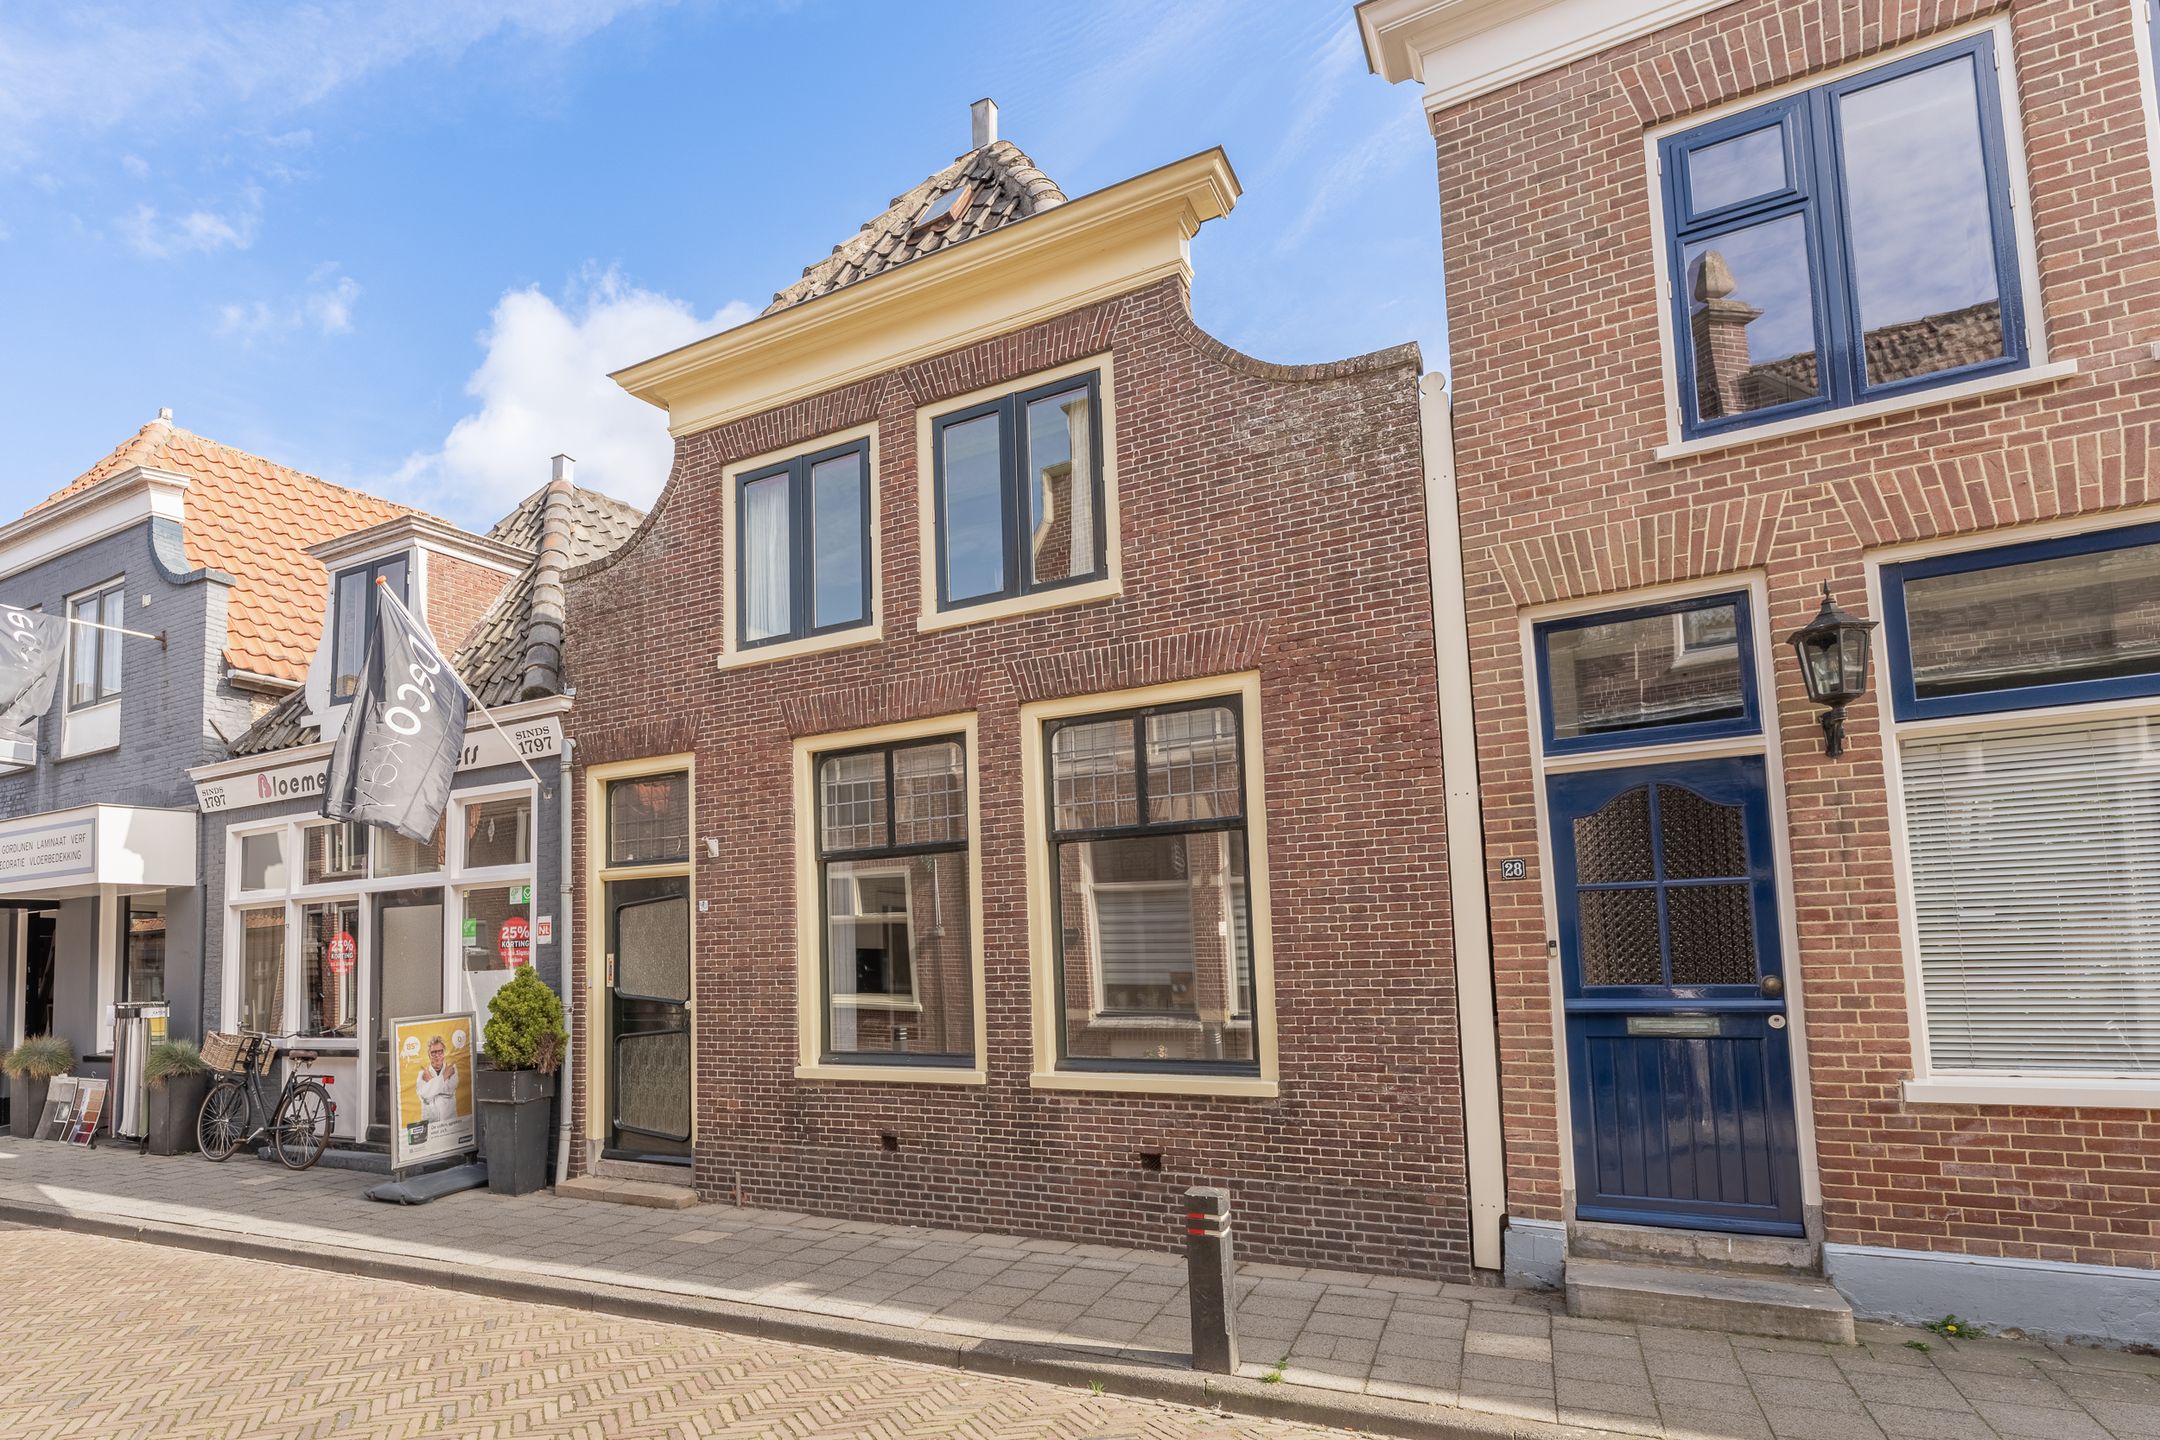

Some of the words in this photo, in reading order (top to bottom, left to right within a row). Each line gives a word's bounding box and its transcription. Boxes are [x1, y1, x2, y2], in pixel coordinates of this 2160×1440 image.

[515, 725, 550, 740] SINDS
[518, 736, 552, 756] 1797
[201, 786, 224, 797] SINDS
[204, 794, 227, 809] 1797
[1, 841, 33, 855] GORDIJNEN
[37, 835, 67, 850] LAMINAAT
[70, 832, 87, 845] VERF
[30, 849, 82, 866] VLOERBEDEKKING
[1504, 862, 1523, 877] 28
[502, 925, 530, 940] 25%
[538, 925, 550, 935] NL
[331, 939, 354, 952] 25%
[501, 939, 530, 949] KORTING
